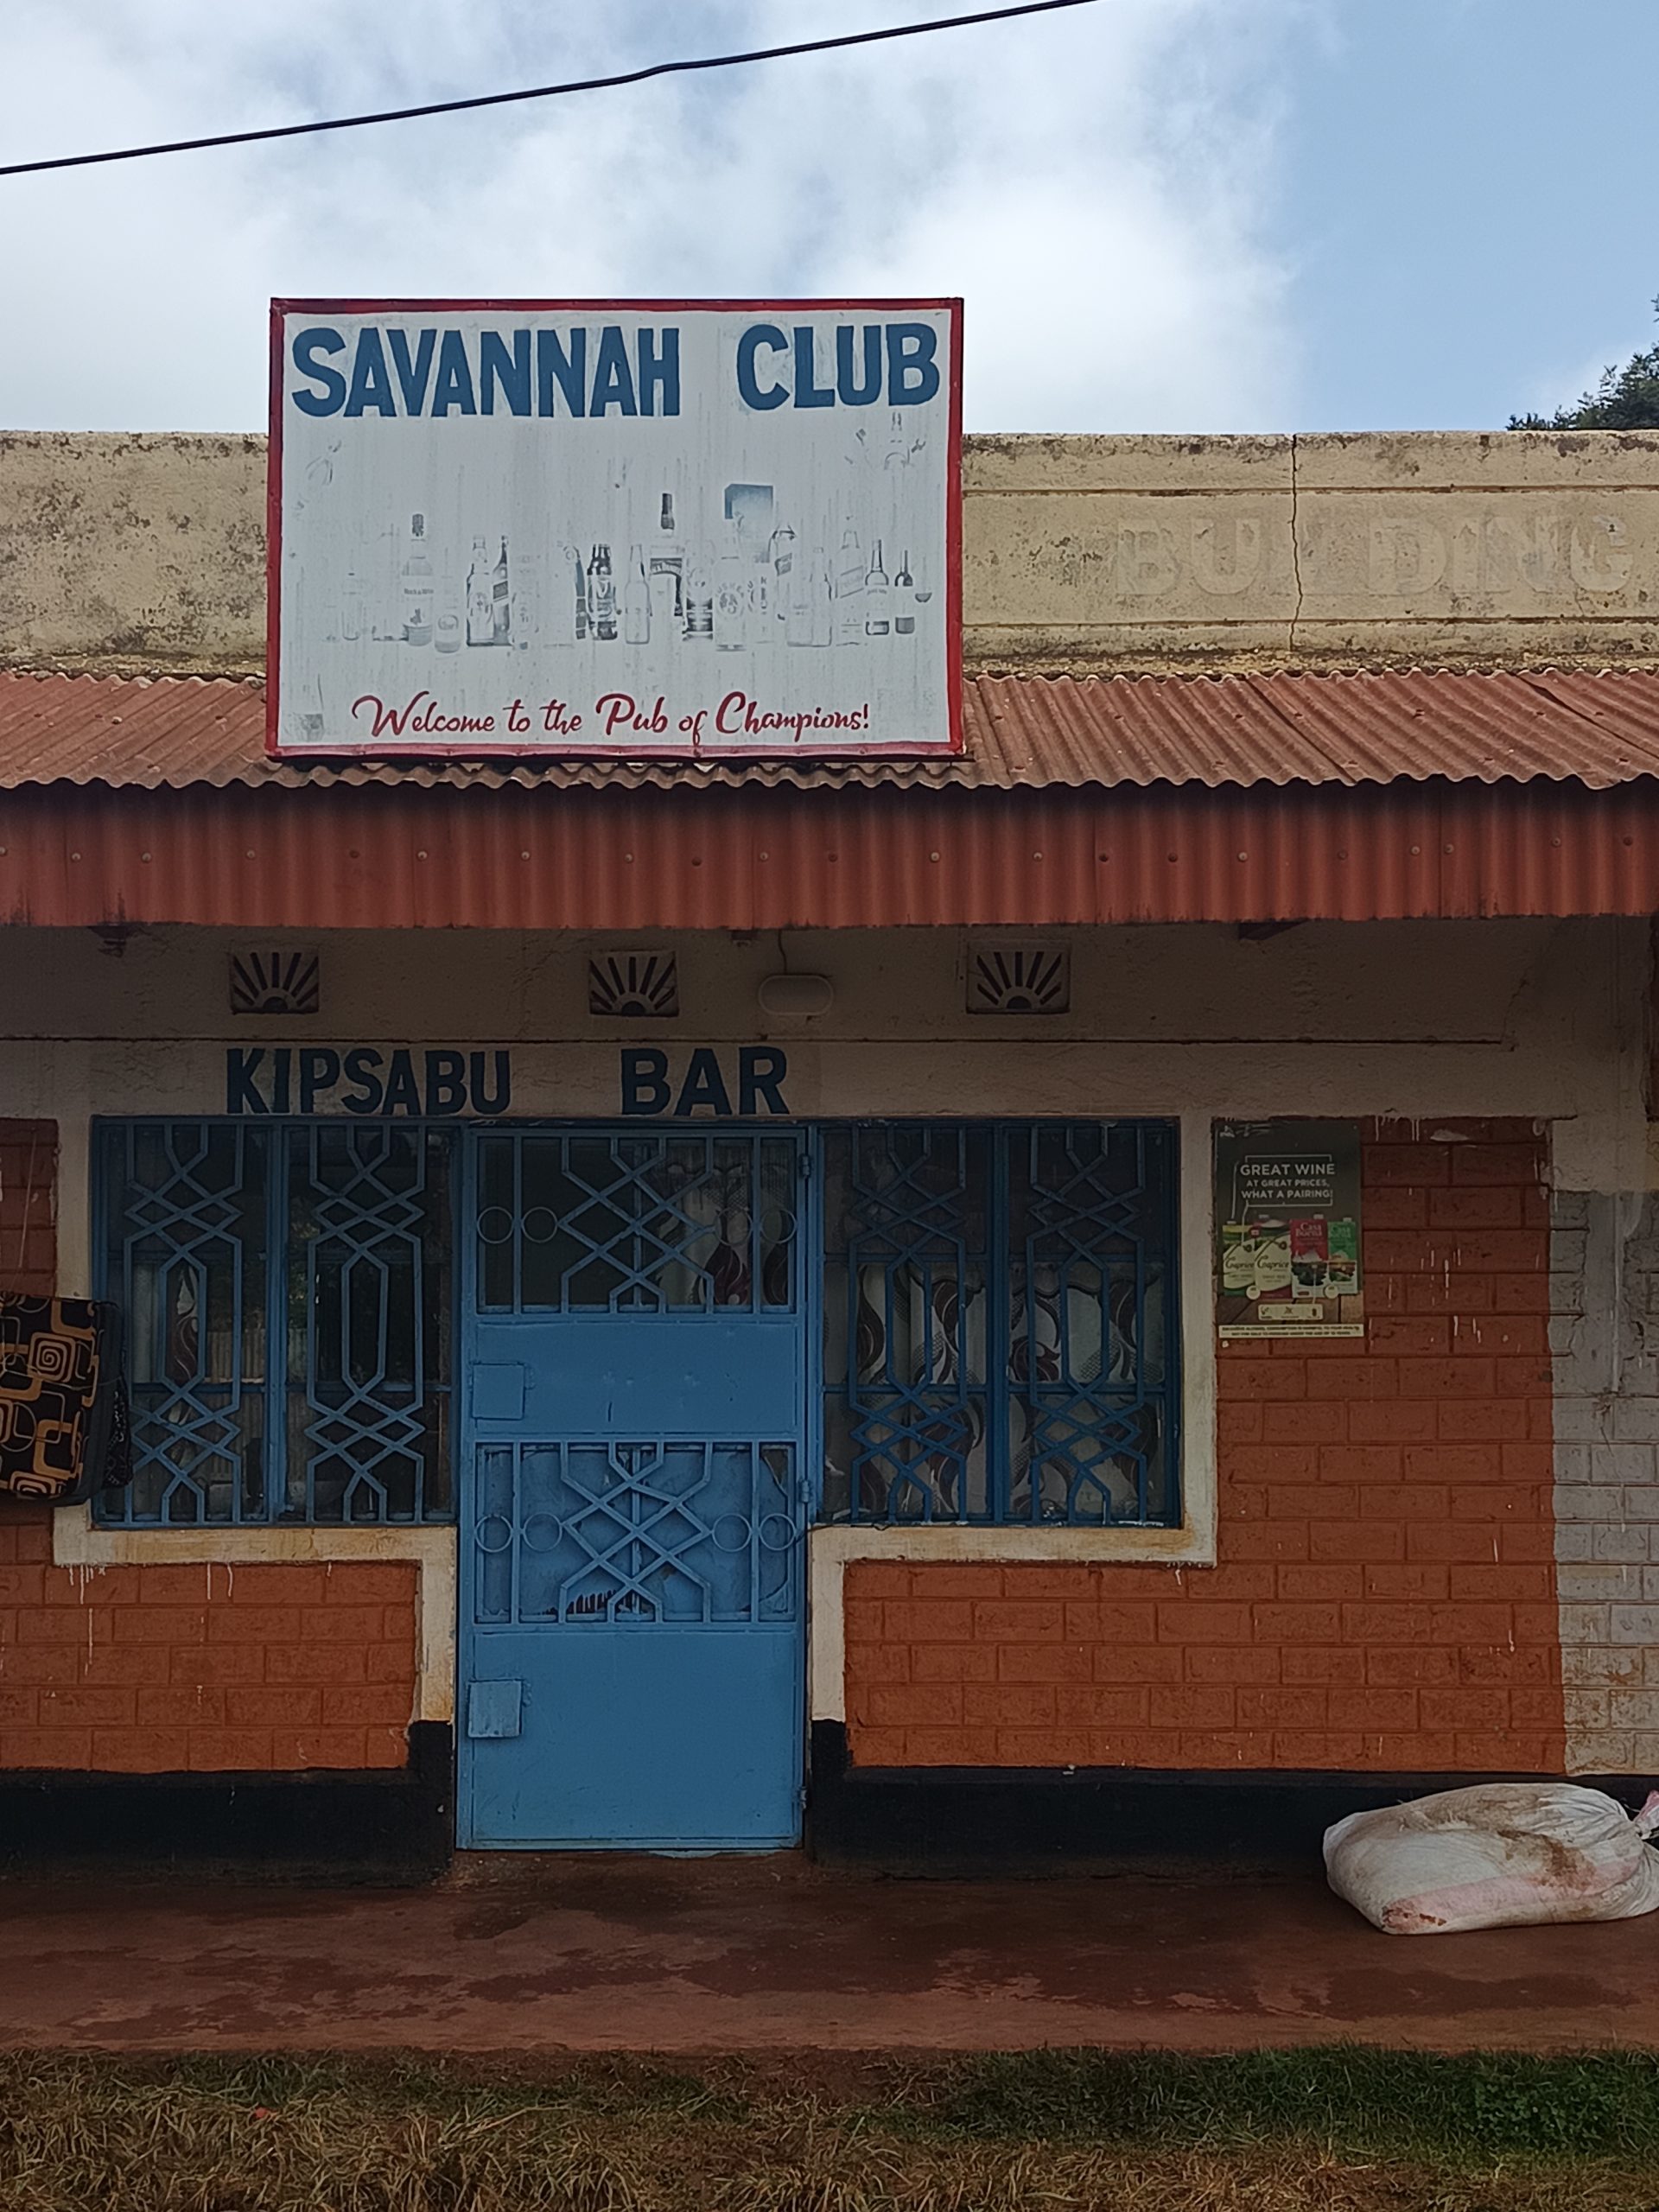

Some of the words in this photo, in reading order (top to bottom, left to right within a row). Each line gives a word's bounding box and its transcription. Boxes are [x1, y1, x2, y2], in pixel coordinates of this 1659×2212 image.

[291, 326, 680, 418] SAVANNAH
[736, 322, 940, 411] CLUB
[352, 690, 495, 738] Welcome
[503, 698, 531, 733] to
[540, 699, 583, 735] the
[595, 692, 668, 736] Pub
[678, 709, 708, 746] of
[715, 690, 870, 742] Champions!
[226, 1046, 511, 1117] KIPSABU
[620, 1045, 790, 1117] BAR
[1240, 1164, 1290, 1175] GREAT
[1294, 1163, 1335, 1175] WINE
[1241, 1190, 1273, 1198] WHAT
[1276, 1190, 1284, 1198] A
[1287, 1189, 1333, 1198] PAIRING!
